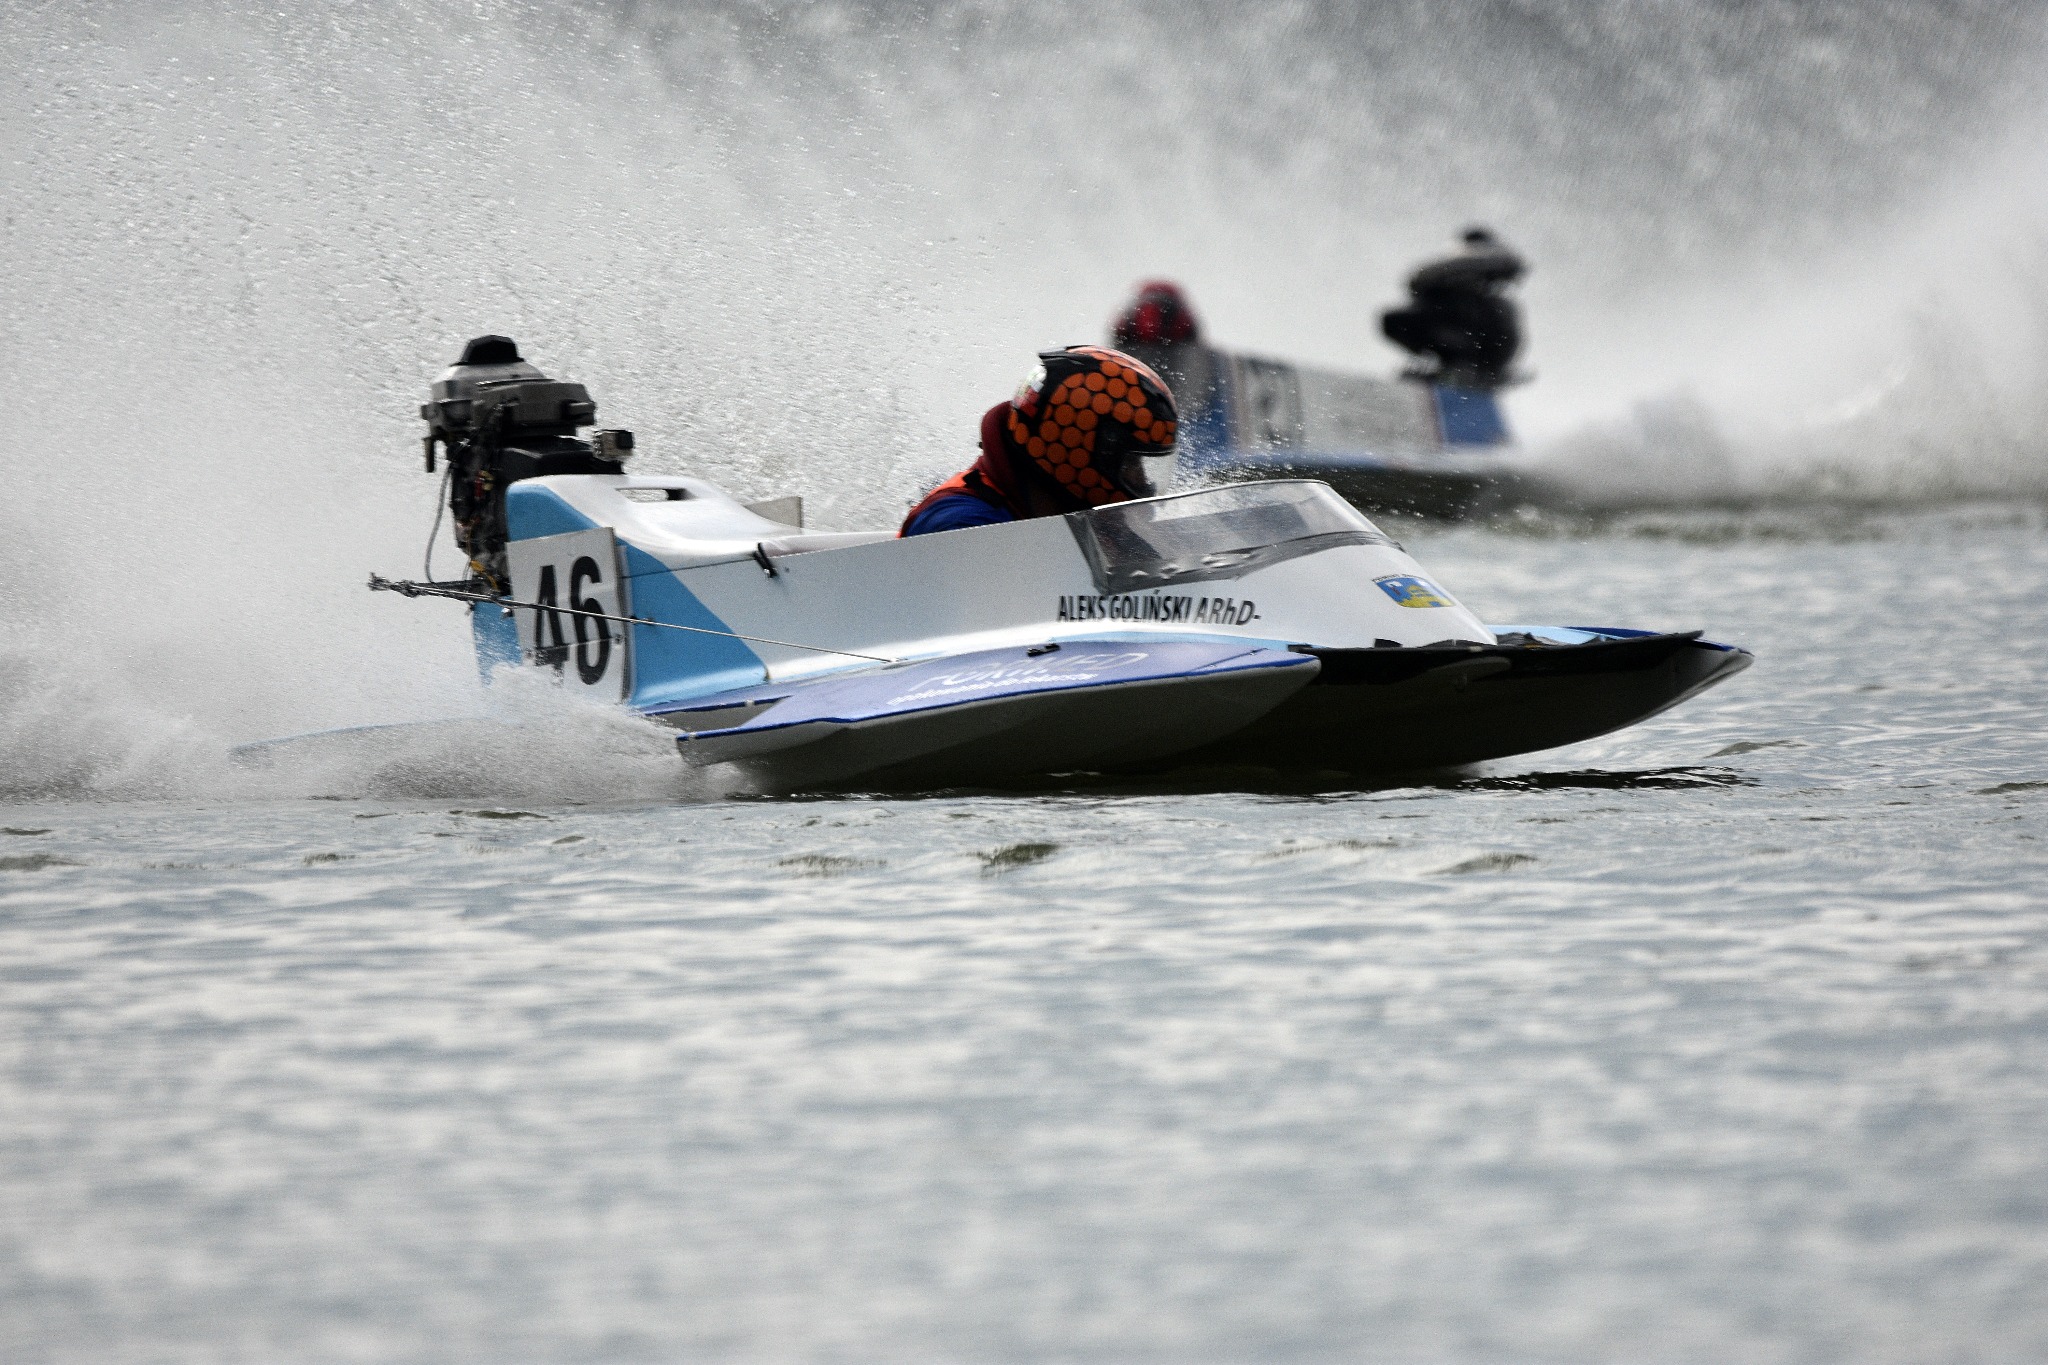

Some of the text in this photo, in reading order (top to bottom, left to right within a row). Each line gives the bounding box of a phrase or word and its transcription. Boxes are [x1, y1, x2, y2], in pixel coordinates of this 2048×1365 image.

[535, 556, 611, 685] 46
[1057, 595, 1107, 621] ALEKS
[1108, 589, 1192, 622] GOLIŃSKI
